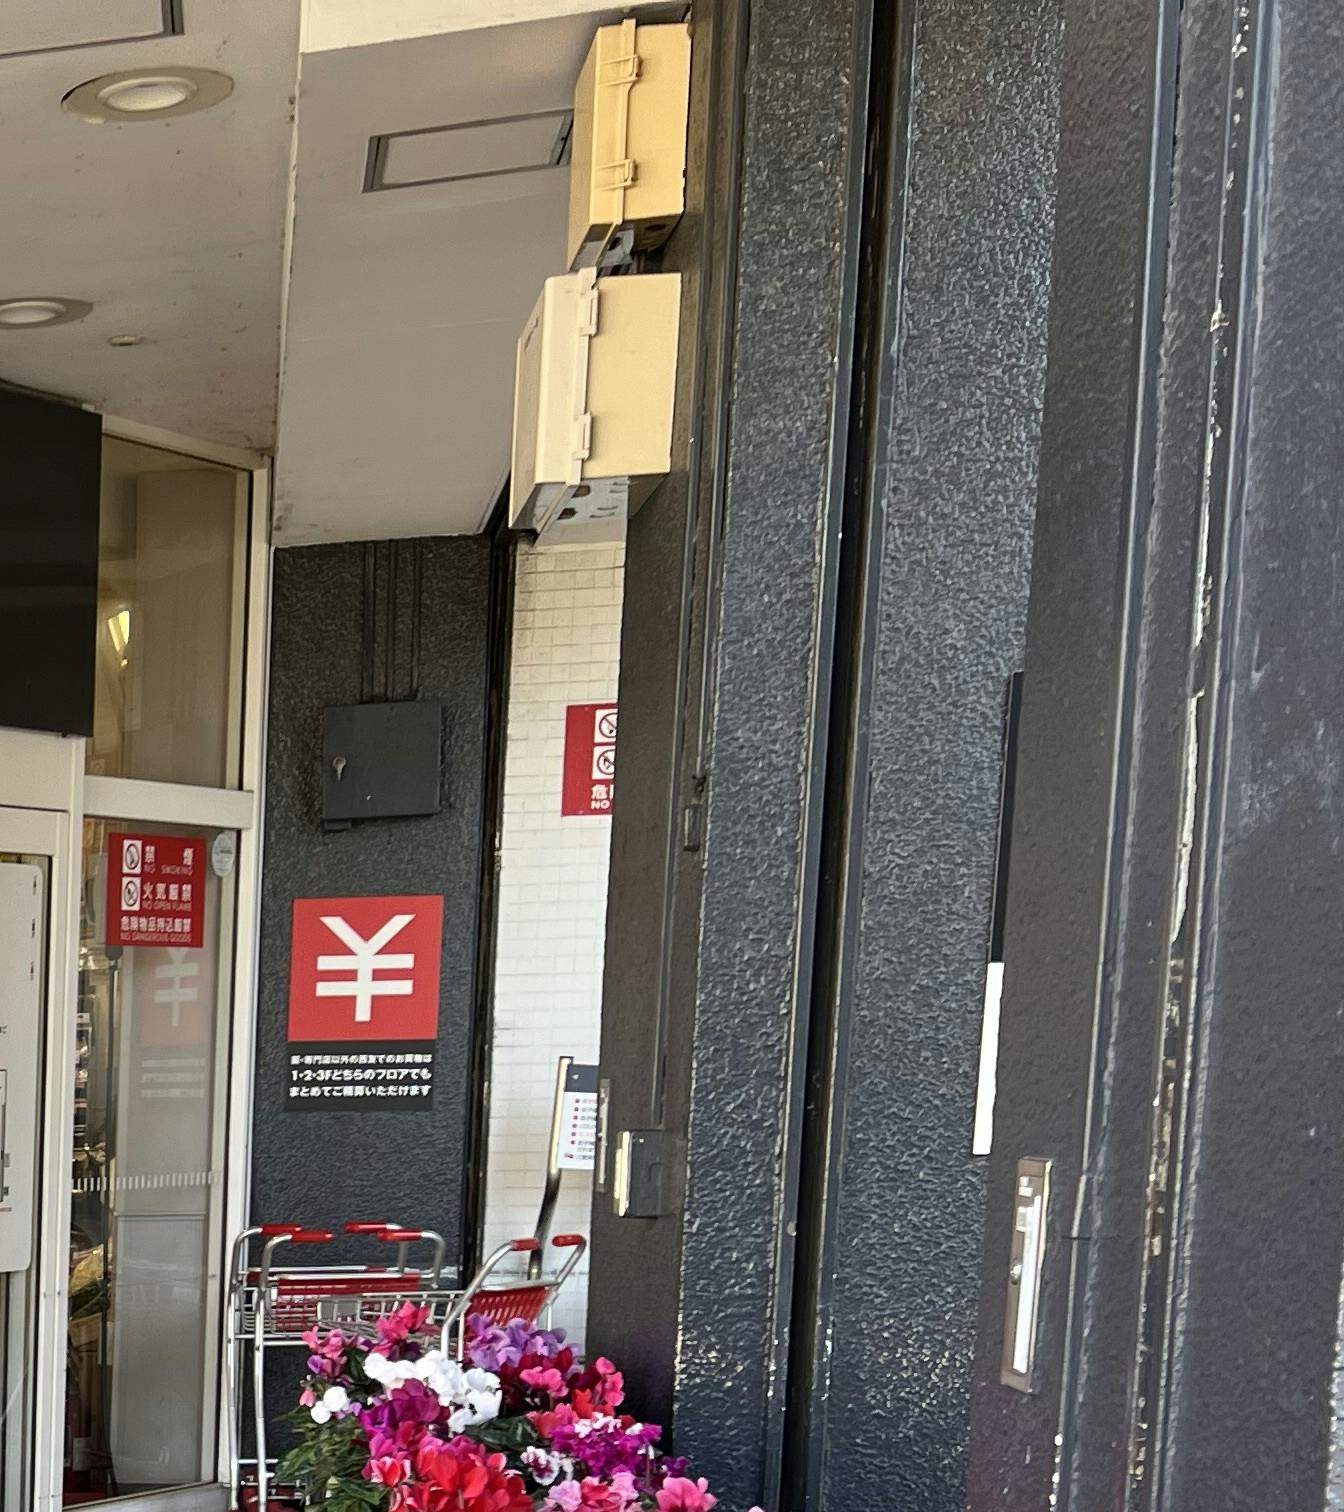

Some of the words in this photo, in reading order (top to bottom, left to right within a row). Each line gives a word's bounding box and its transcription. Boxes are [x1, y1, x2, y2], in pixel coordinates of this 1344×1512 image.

[592, 784, 614, 800] 危
[591, 800, 610, 810] NO
[315, 914, 416, 1022] ¥
